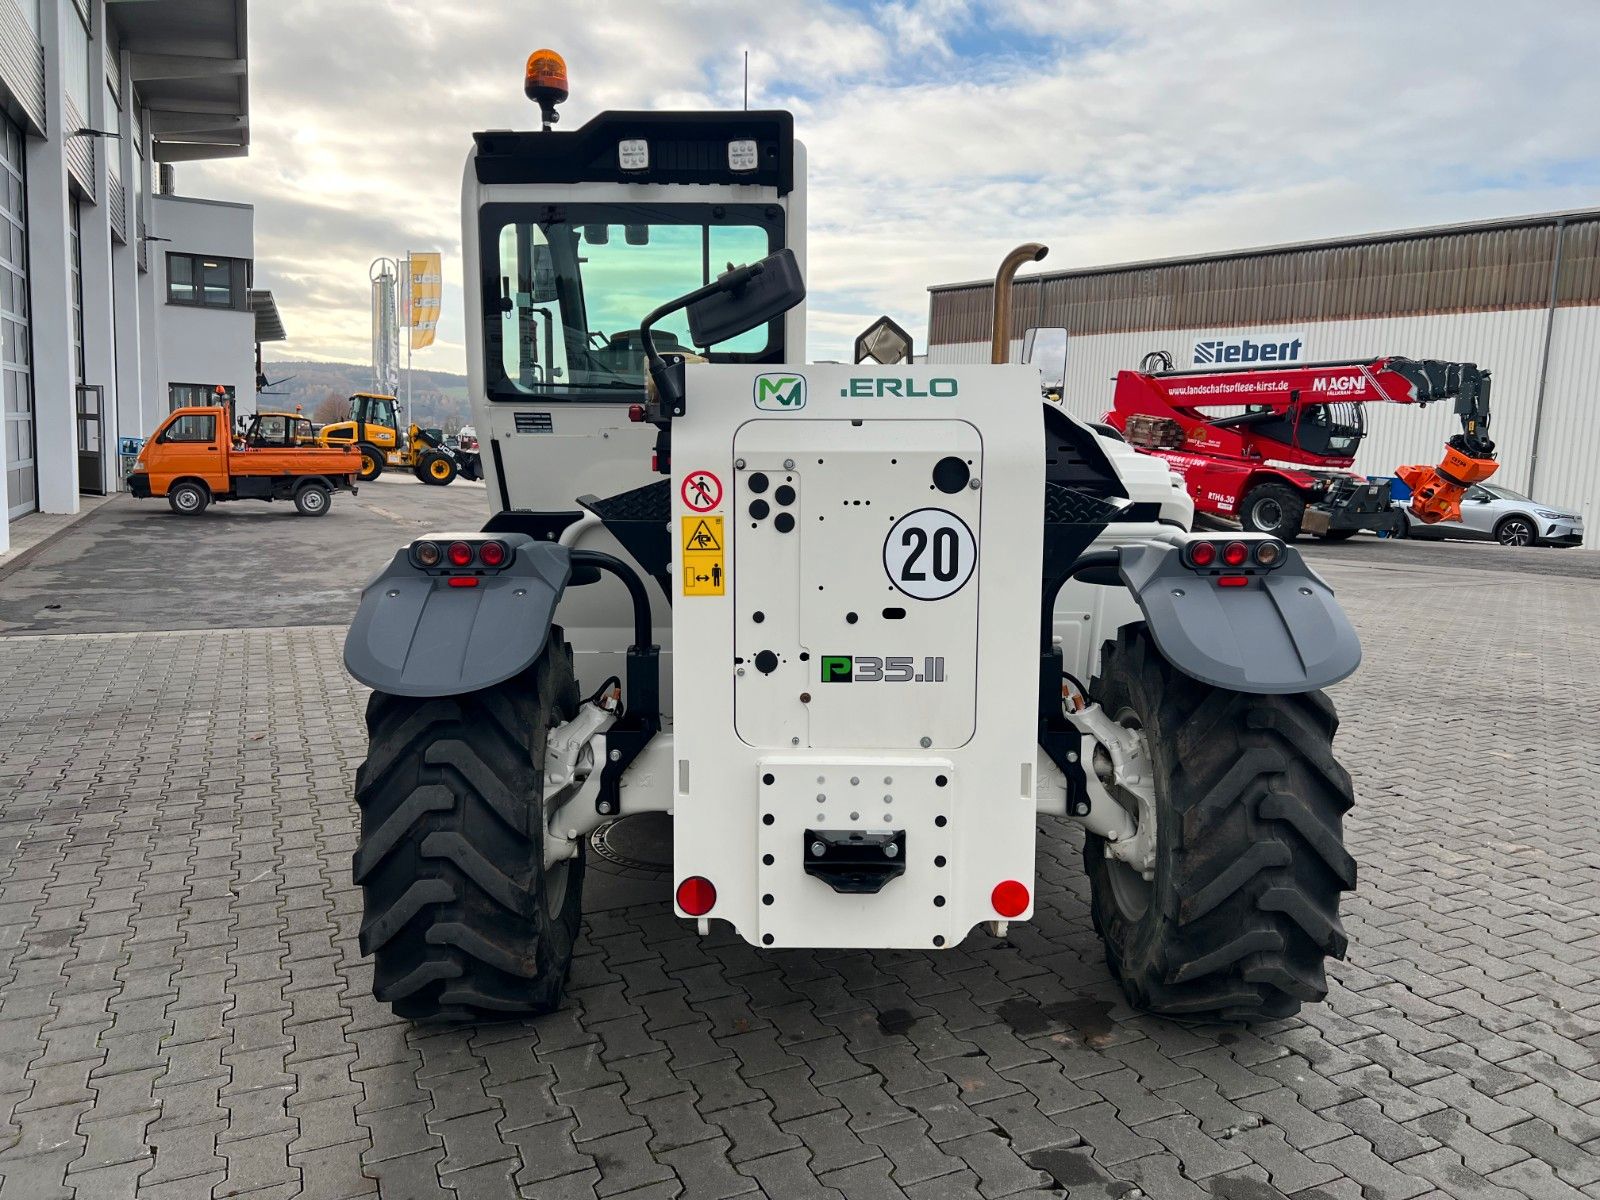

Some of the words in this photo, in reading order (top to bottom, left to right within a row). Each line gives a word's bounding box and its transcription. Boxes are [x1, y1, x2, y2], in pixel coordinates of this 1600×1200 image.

[1194, 337, 1302, 363] Siebert
[1168, 381, 1289, 396] www.landschaftspflege-kirst.de
[1312, 375, 1366, 391] MAGNI
[437, 444, 456, 458] JCB
[1208, 491, 1235, 504] RTH6.30
[901, 527, 959, 582] 20
